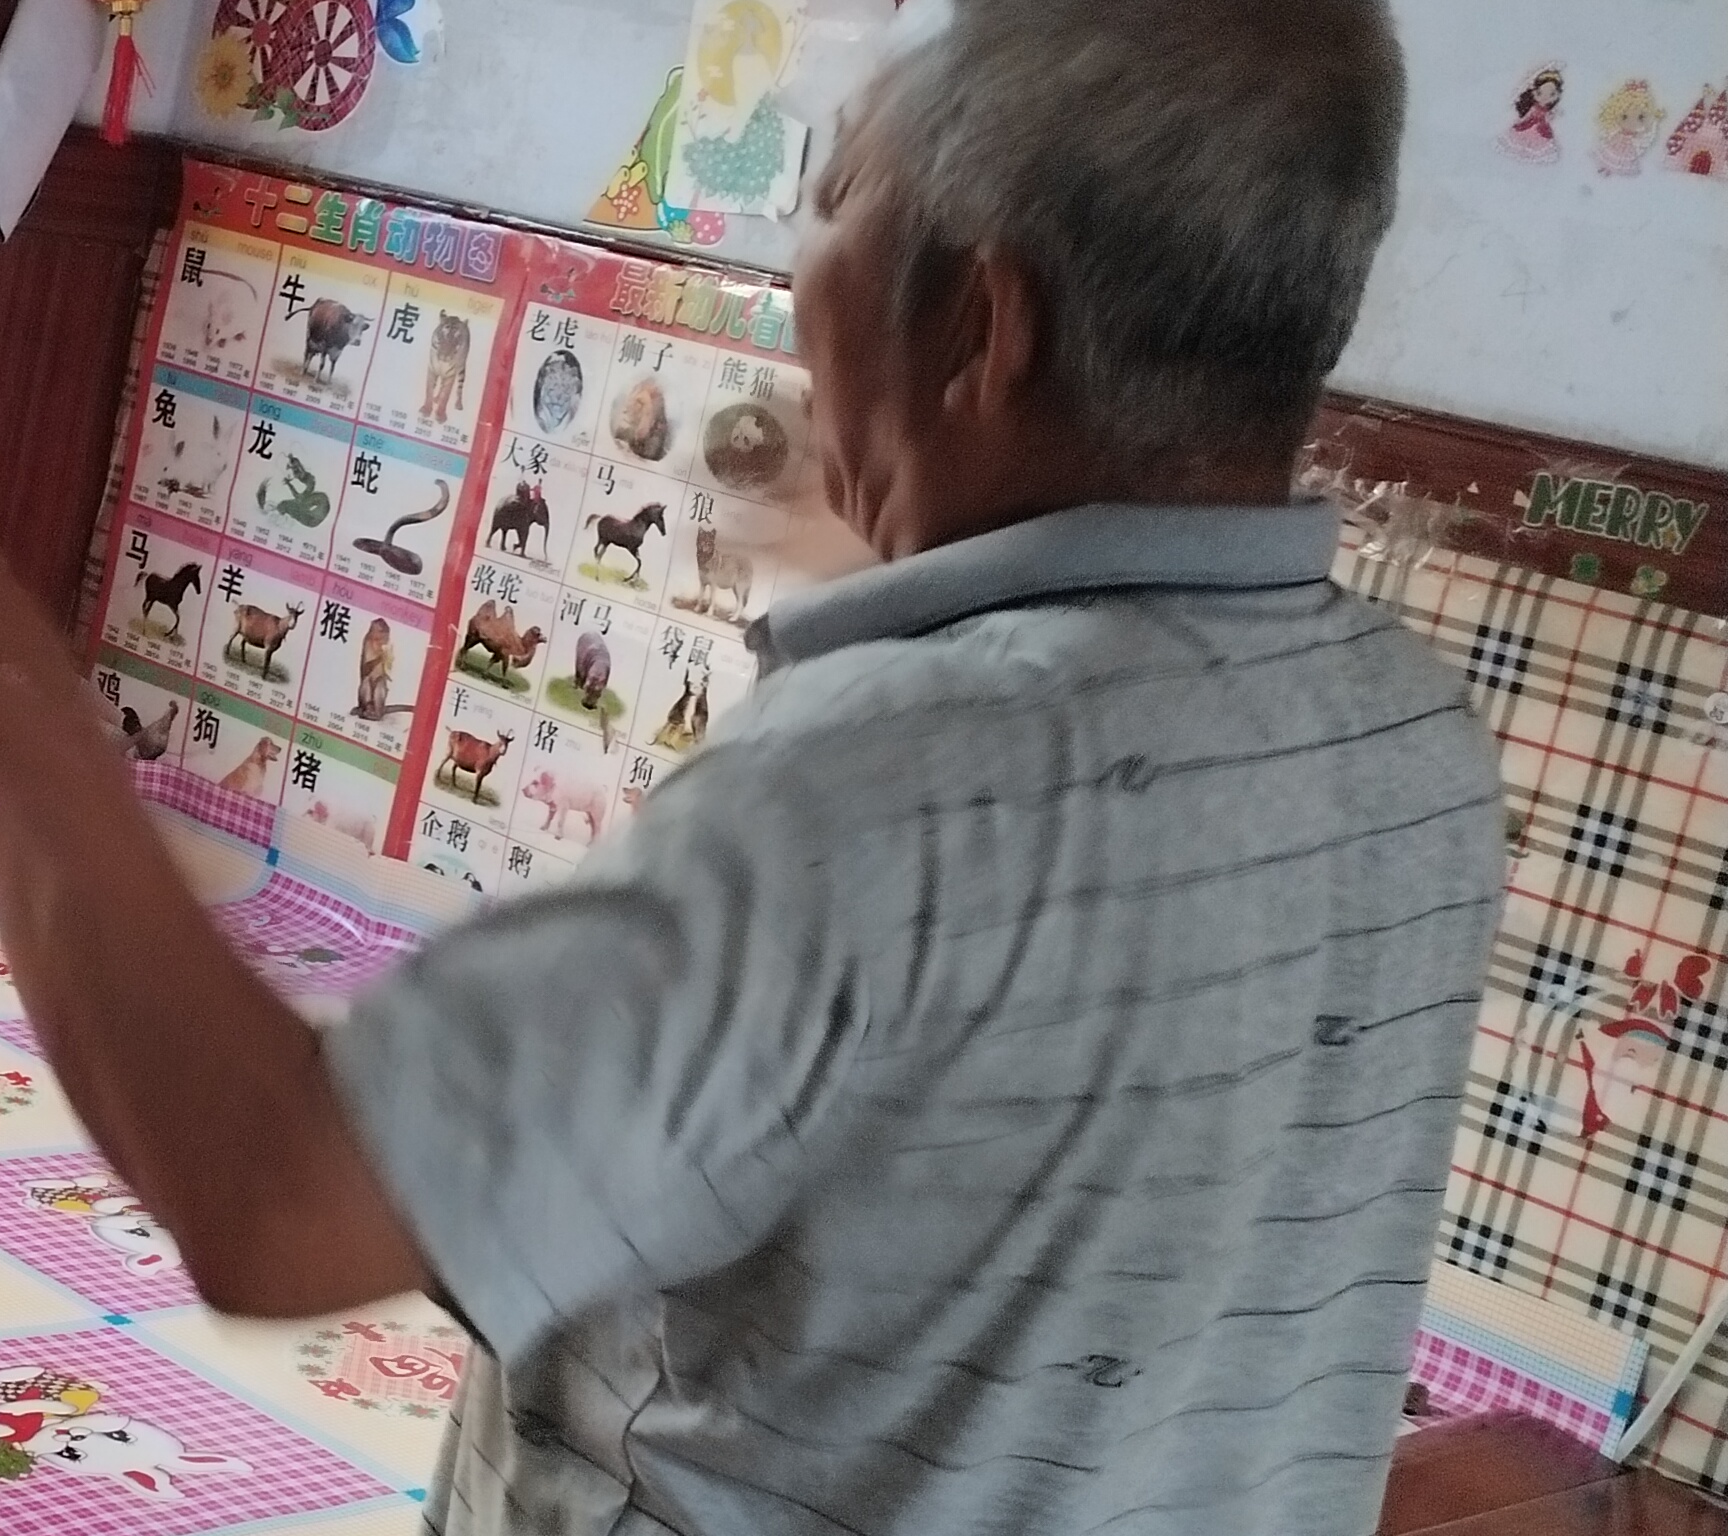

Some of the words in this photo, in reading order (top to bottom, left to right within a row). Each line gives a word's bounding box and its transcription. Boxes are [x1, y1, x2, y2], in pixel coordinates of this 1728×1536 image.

[244, 175, 503, 284] 十二生肖动物图
[180, 246, 207, 287] 鼠
[237, 241, 273, 261] mouse
[278, 274, 306, 316] 牛
[386, 302, 421, 344] 虎
[525, 308, 580, 350] 老虎
[617, 332, 674, 374] 狮子
[717, 356, 778, 401] 熊猫
[151, 388, 177, 429] 兔
[247, 420, 276, 460] 龙
[460, 434, 469, 444] 年
[501, 436, 551, 477] 大象
[350, 451, 382, 495] 蛇
[595, 464, 617, 496] 马
[689, 491, 715, 526] 狼
[1522, 471, 1710, 555] MERRY
[125, 529, 150, 570] 马
[317, 551, 325, 560] 年
[218, 564, 246, 603] 羊
[426, 589, 434, 599] 年
[470, 562, 522, 606] 骆驼
[320, 599, 351, 644] 猴
[559, 591, 613, 636] 河马
[657, 623, 714, 672] 袋鼠
[286, 699, 293, 708] 年
[449, 686, 470, 719] 羊
[192, 707, 220, 749] 狗
[395, 742, 402, 752] 年
[533, 718, 559, 755] 猪
[290, 748, 321, 794] 猪
[628, 754, 654, 790] 狗
[419, 808, 472, 853] 企鹅
[508, 844, 534, 879] 鹅
[368, 1346, 464, 1400] 福
